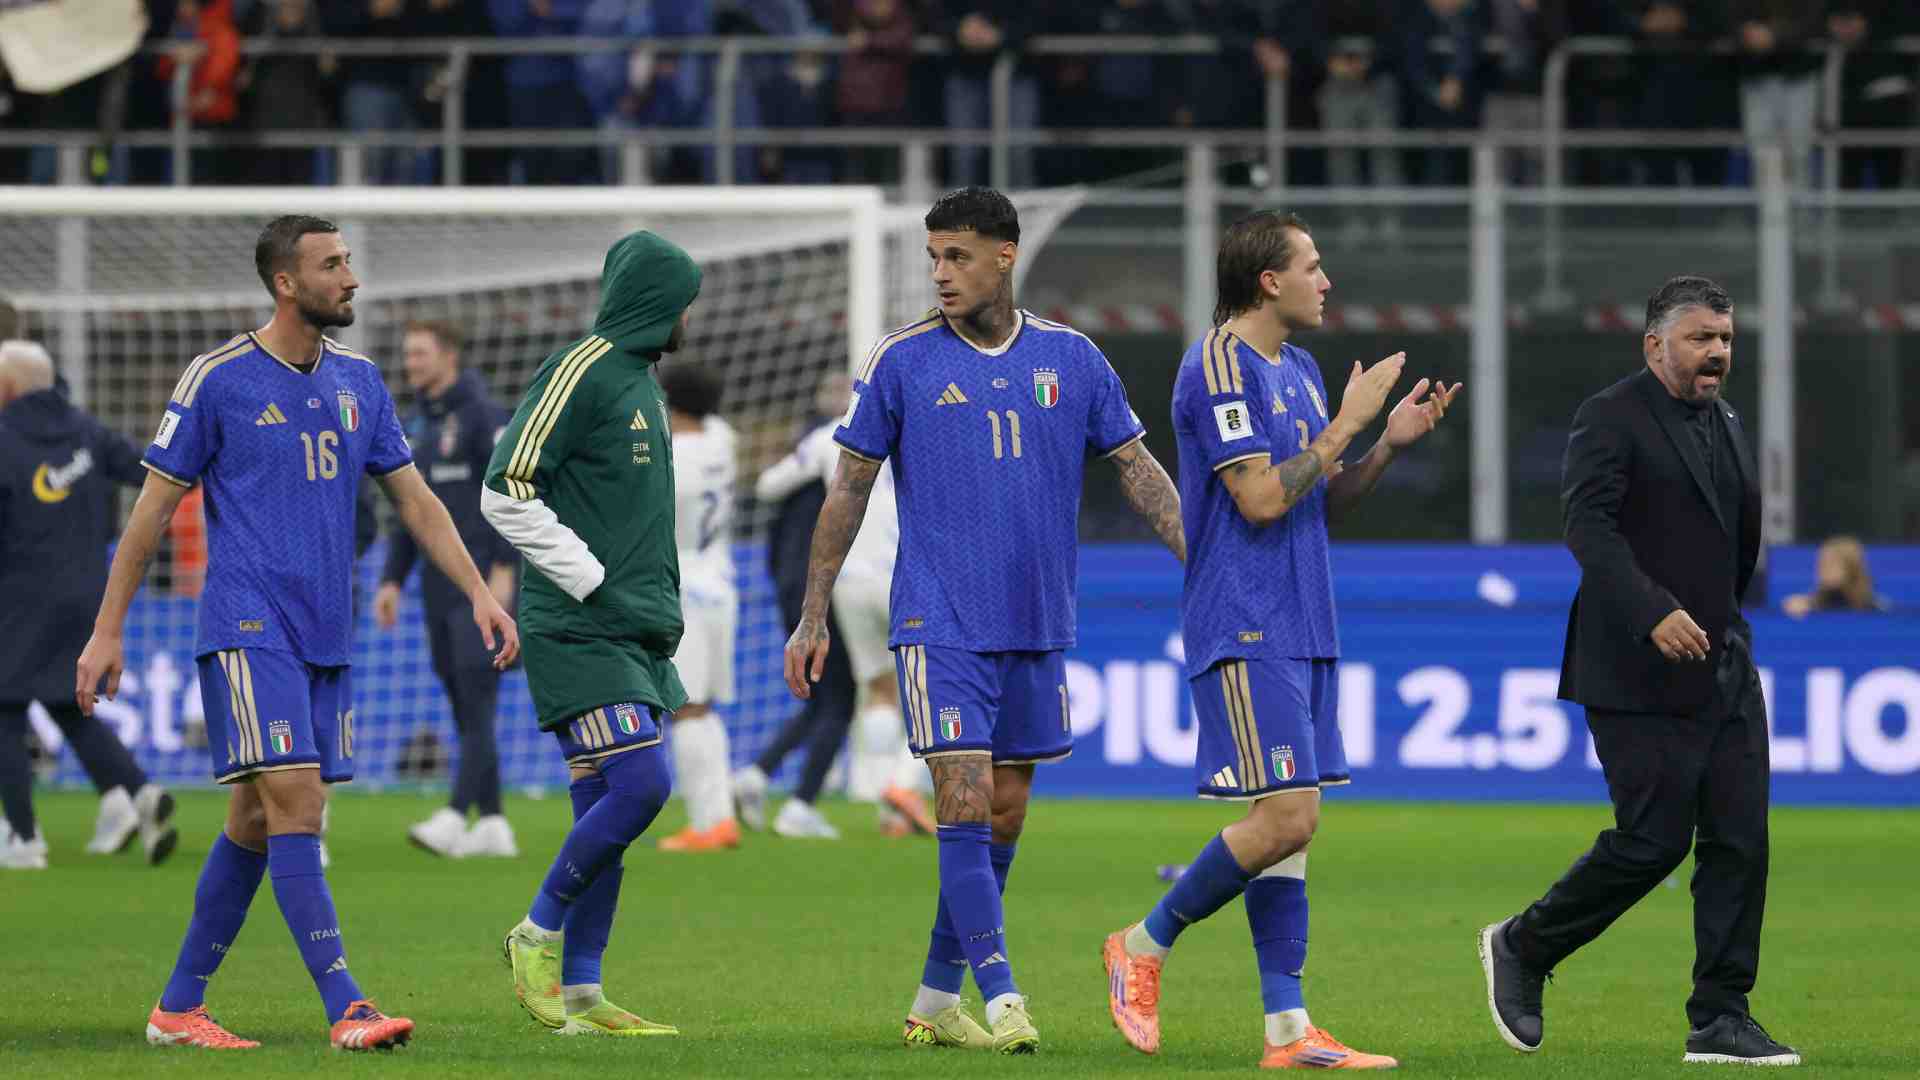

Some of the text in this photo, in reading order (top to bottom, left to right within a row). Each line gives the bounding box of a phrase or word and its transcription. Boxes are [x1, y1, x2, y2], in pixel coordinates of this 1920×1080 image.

[300, 431, 338, 480] 16
[987, 410, 1021, 458] 11
[1397, 665, 1571, 771] 2.5
